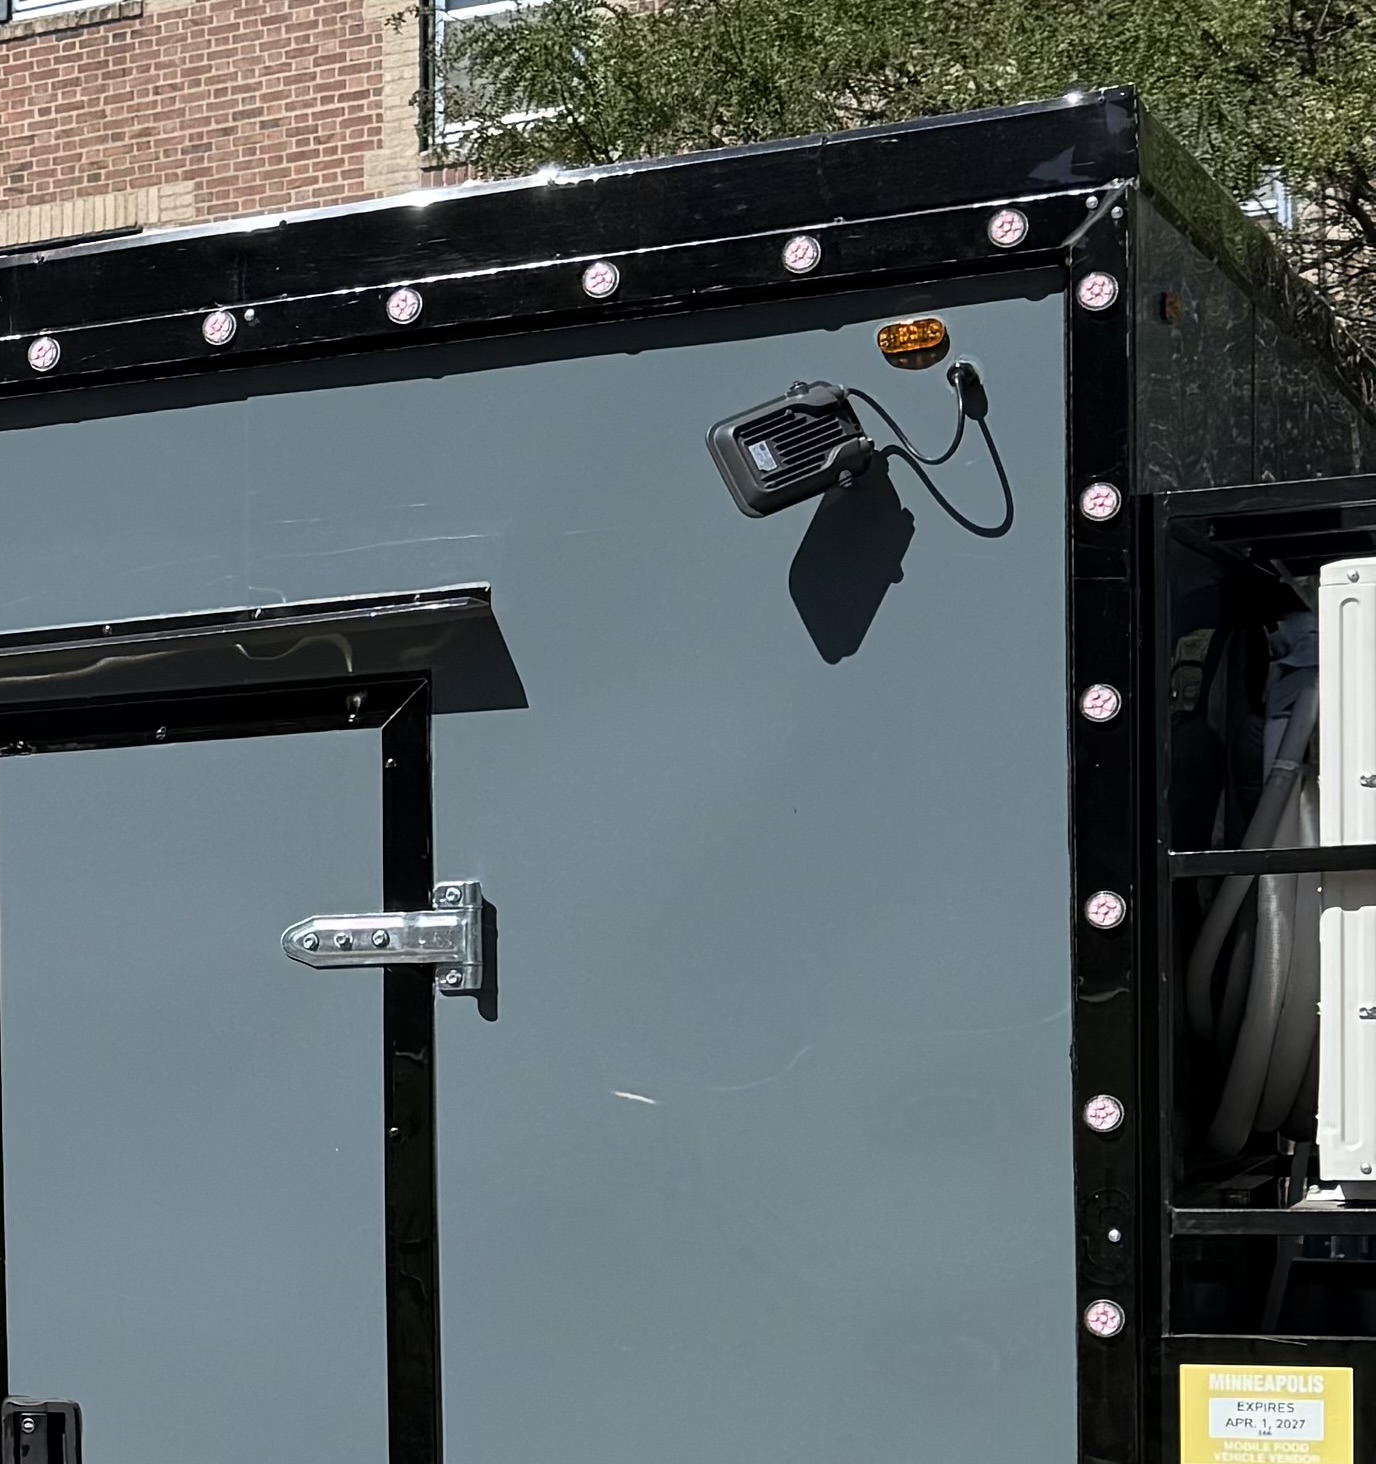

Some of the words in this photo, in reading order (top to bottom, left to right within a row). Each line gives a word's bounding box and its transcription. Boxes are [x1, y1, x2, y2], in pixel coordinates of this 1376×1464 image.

[1209, 1374, 1324, 1393] MINNEAPOLIS
[1237, 1401, 1295, 1413] EXPIRES
[1225, 1418, 1256, 1428] APR.
[1262, 1418, 1271, 1430] 1,
[1276, 1419, 1305, 1429] 2027
[1224, 1441, 1270, 1452] MOBILE
[1273, 1442, 1309, 1453] FOOD
[1212, 1451, 1266, 1463] VEHICLE
